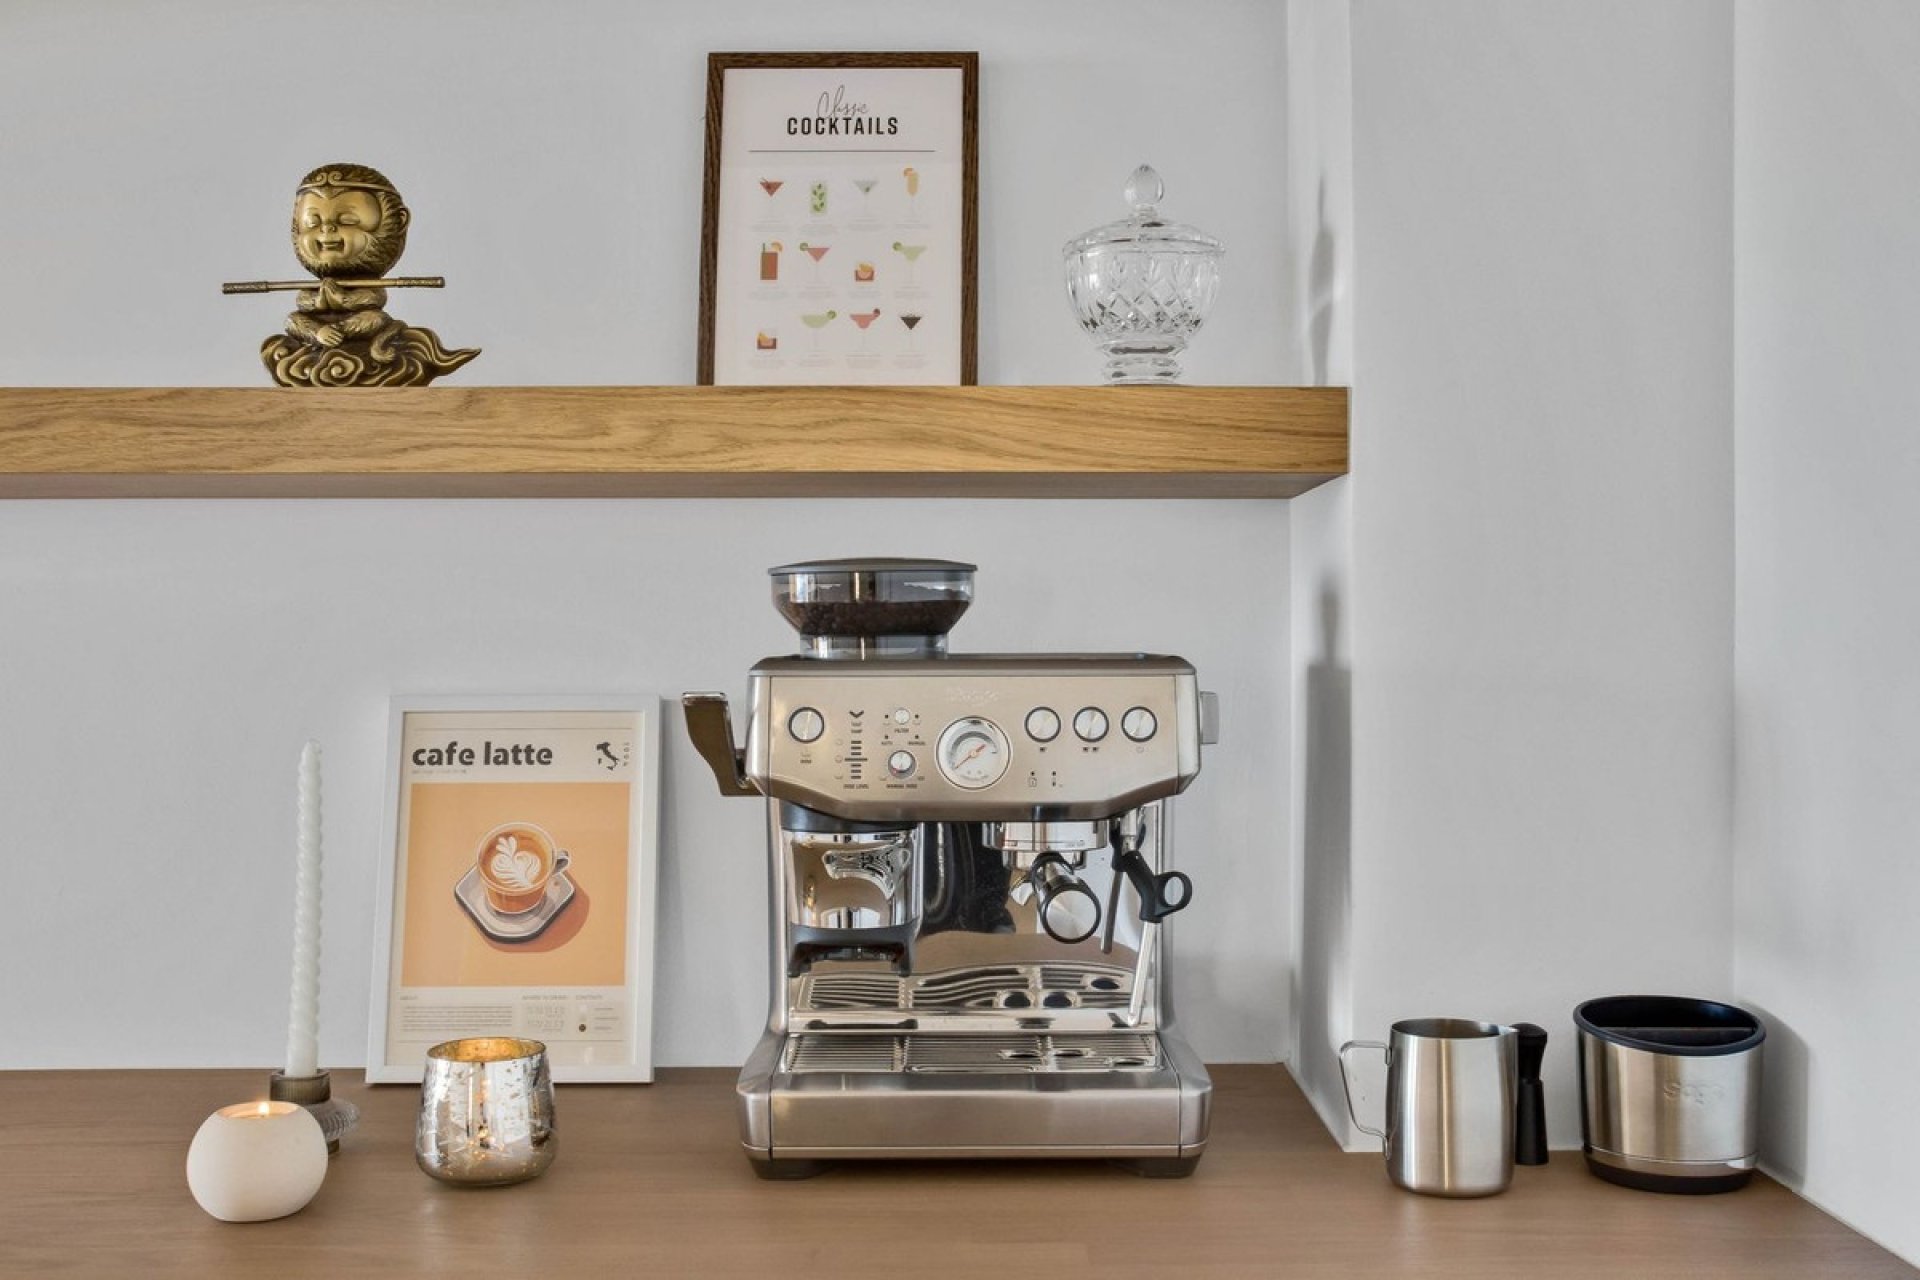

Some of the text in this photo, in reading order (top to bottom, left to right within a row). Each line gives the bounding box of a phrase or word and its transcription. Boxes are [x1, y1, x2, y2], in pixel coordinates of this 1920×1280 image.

[816, 84, 870, 118] Classic
[787, 116, 898, 135] COCKTAILS
[412, 741, 553, 766] cafe latte
